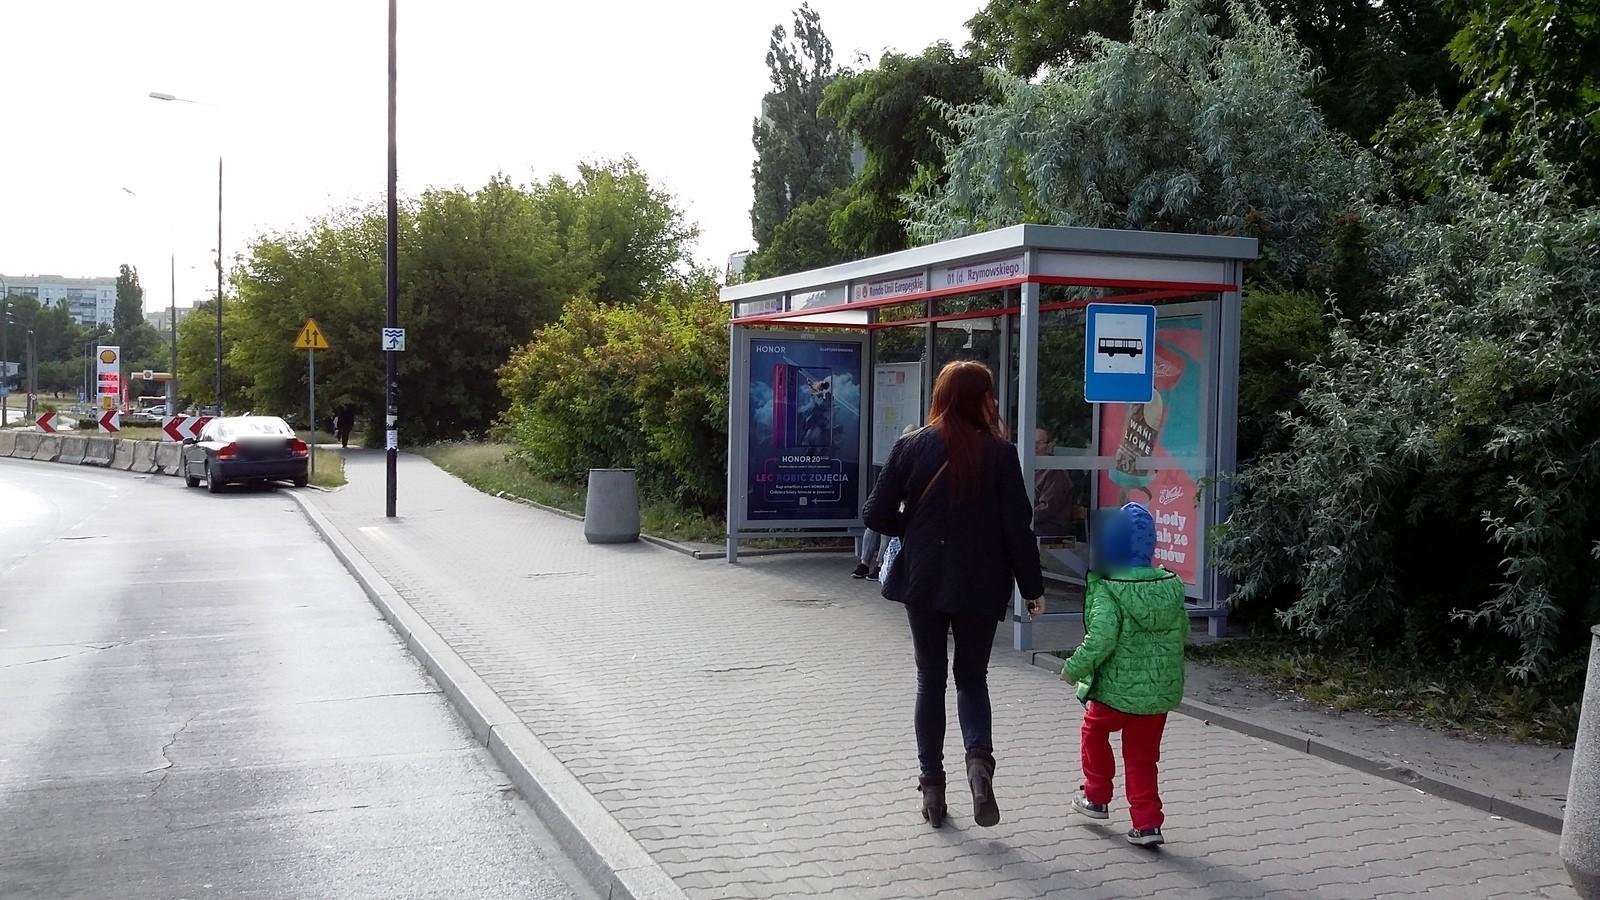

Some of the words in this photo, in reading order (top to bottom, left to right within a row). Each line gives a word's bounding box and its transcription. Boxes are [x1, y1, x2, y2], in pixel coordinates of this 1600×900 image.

[946, 272, 955, 285] 01
[967, 262, 1020, 283] Rzymowskiego
[756, 345, 786, 354] HONOR
[1130, 419, 1152, 441] WANI
[1124, 429, 1151, 455] LIOWE
[782, 455, 811, 463] HONOR
[811, 455, 821, 463] 20
[808, 473, 849, 484] ZDJĘCIA
[1155, 509, 1187, 532] Lody
[1156, 527, 1172, 544] ak
[1173, 533, 1188, 546] ze
[1154, 545, 1186, 564] snów
